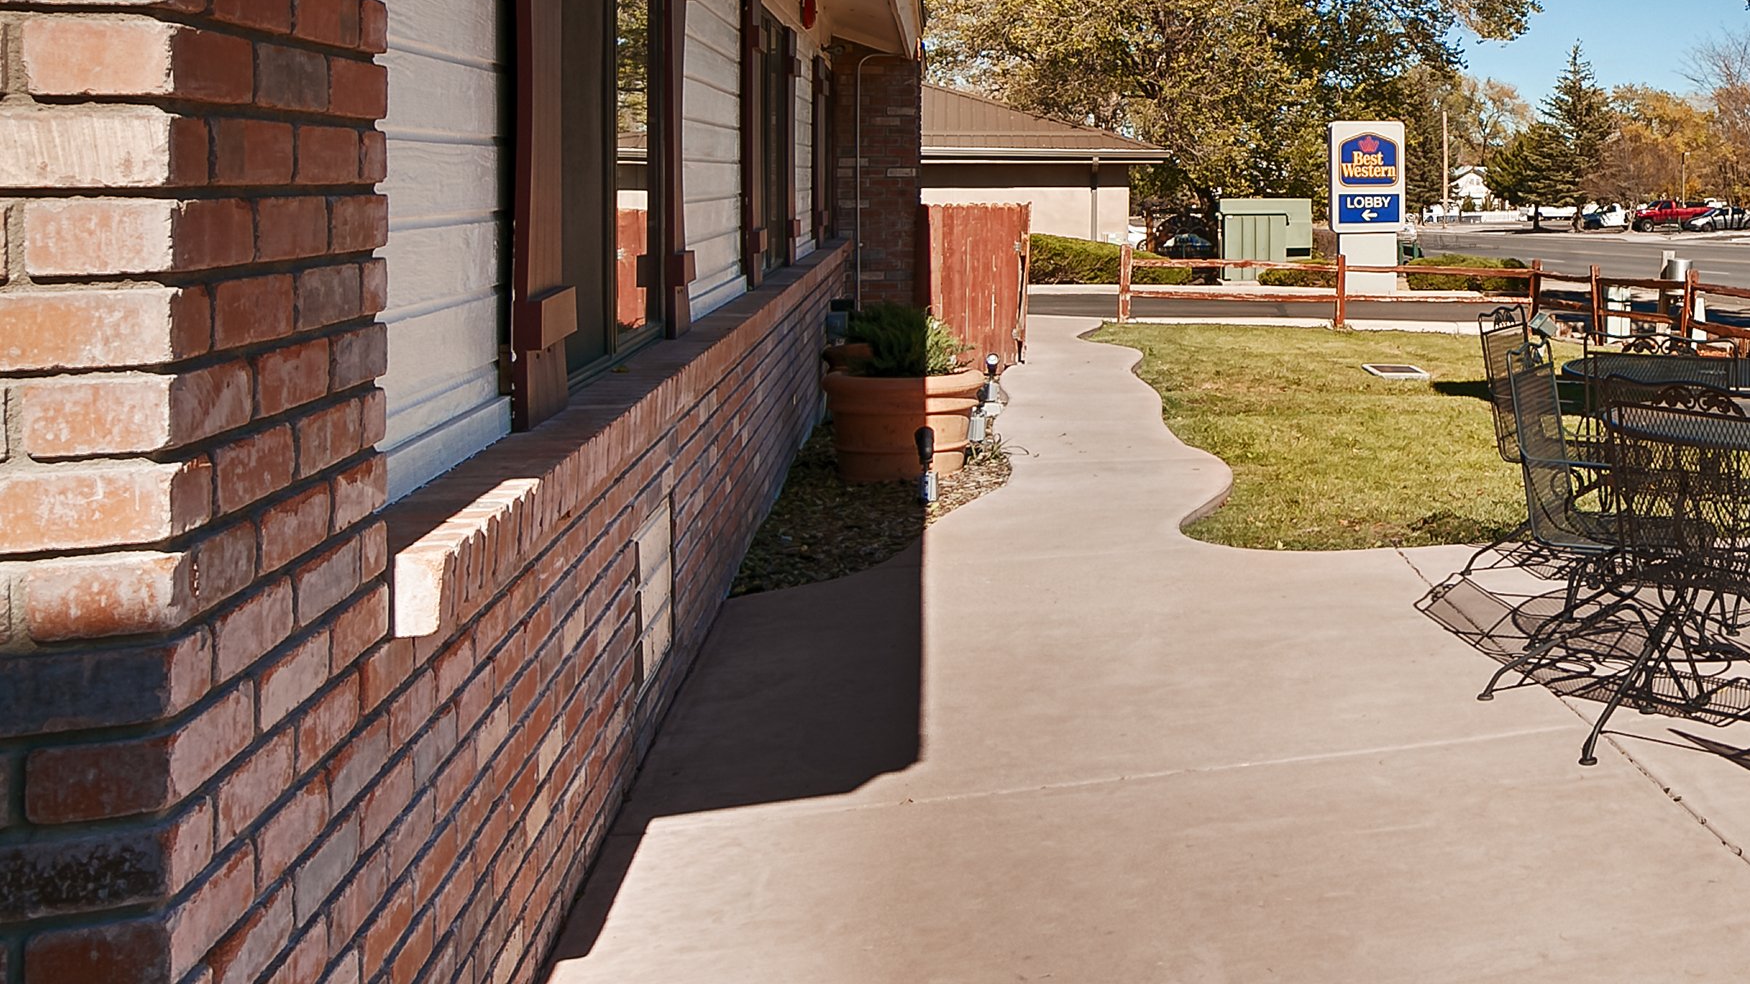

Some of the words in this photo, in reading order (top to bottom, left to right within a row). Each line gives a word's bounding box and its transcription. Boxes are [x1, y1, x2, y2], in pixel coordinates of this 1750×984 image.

[1352, 151, 1384, 166] Best
[1341, 162, 1397, 178] Western
[1346, 196, 1392, 208] LOBBY
